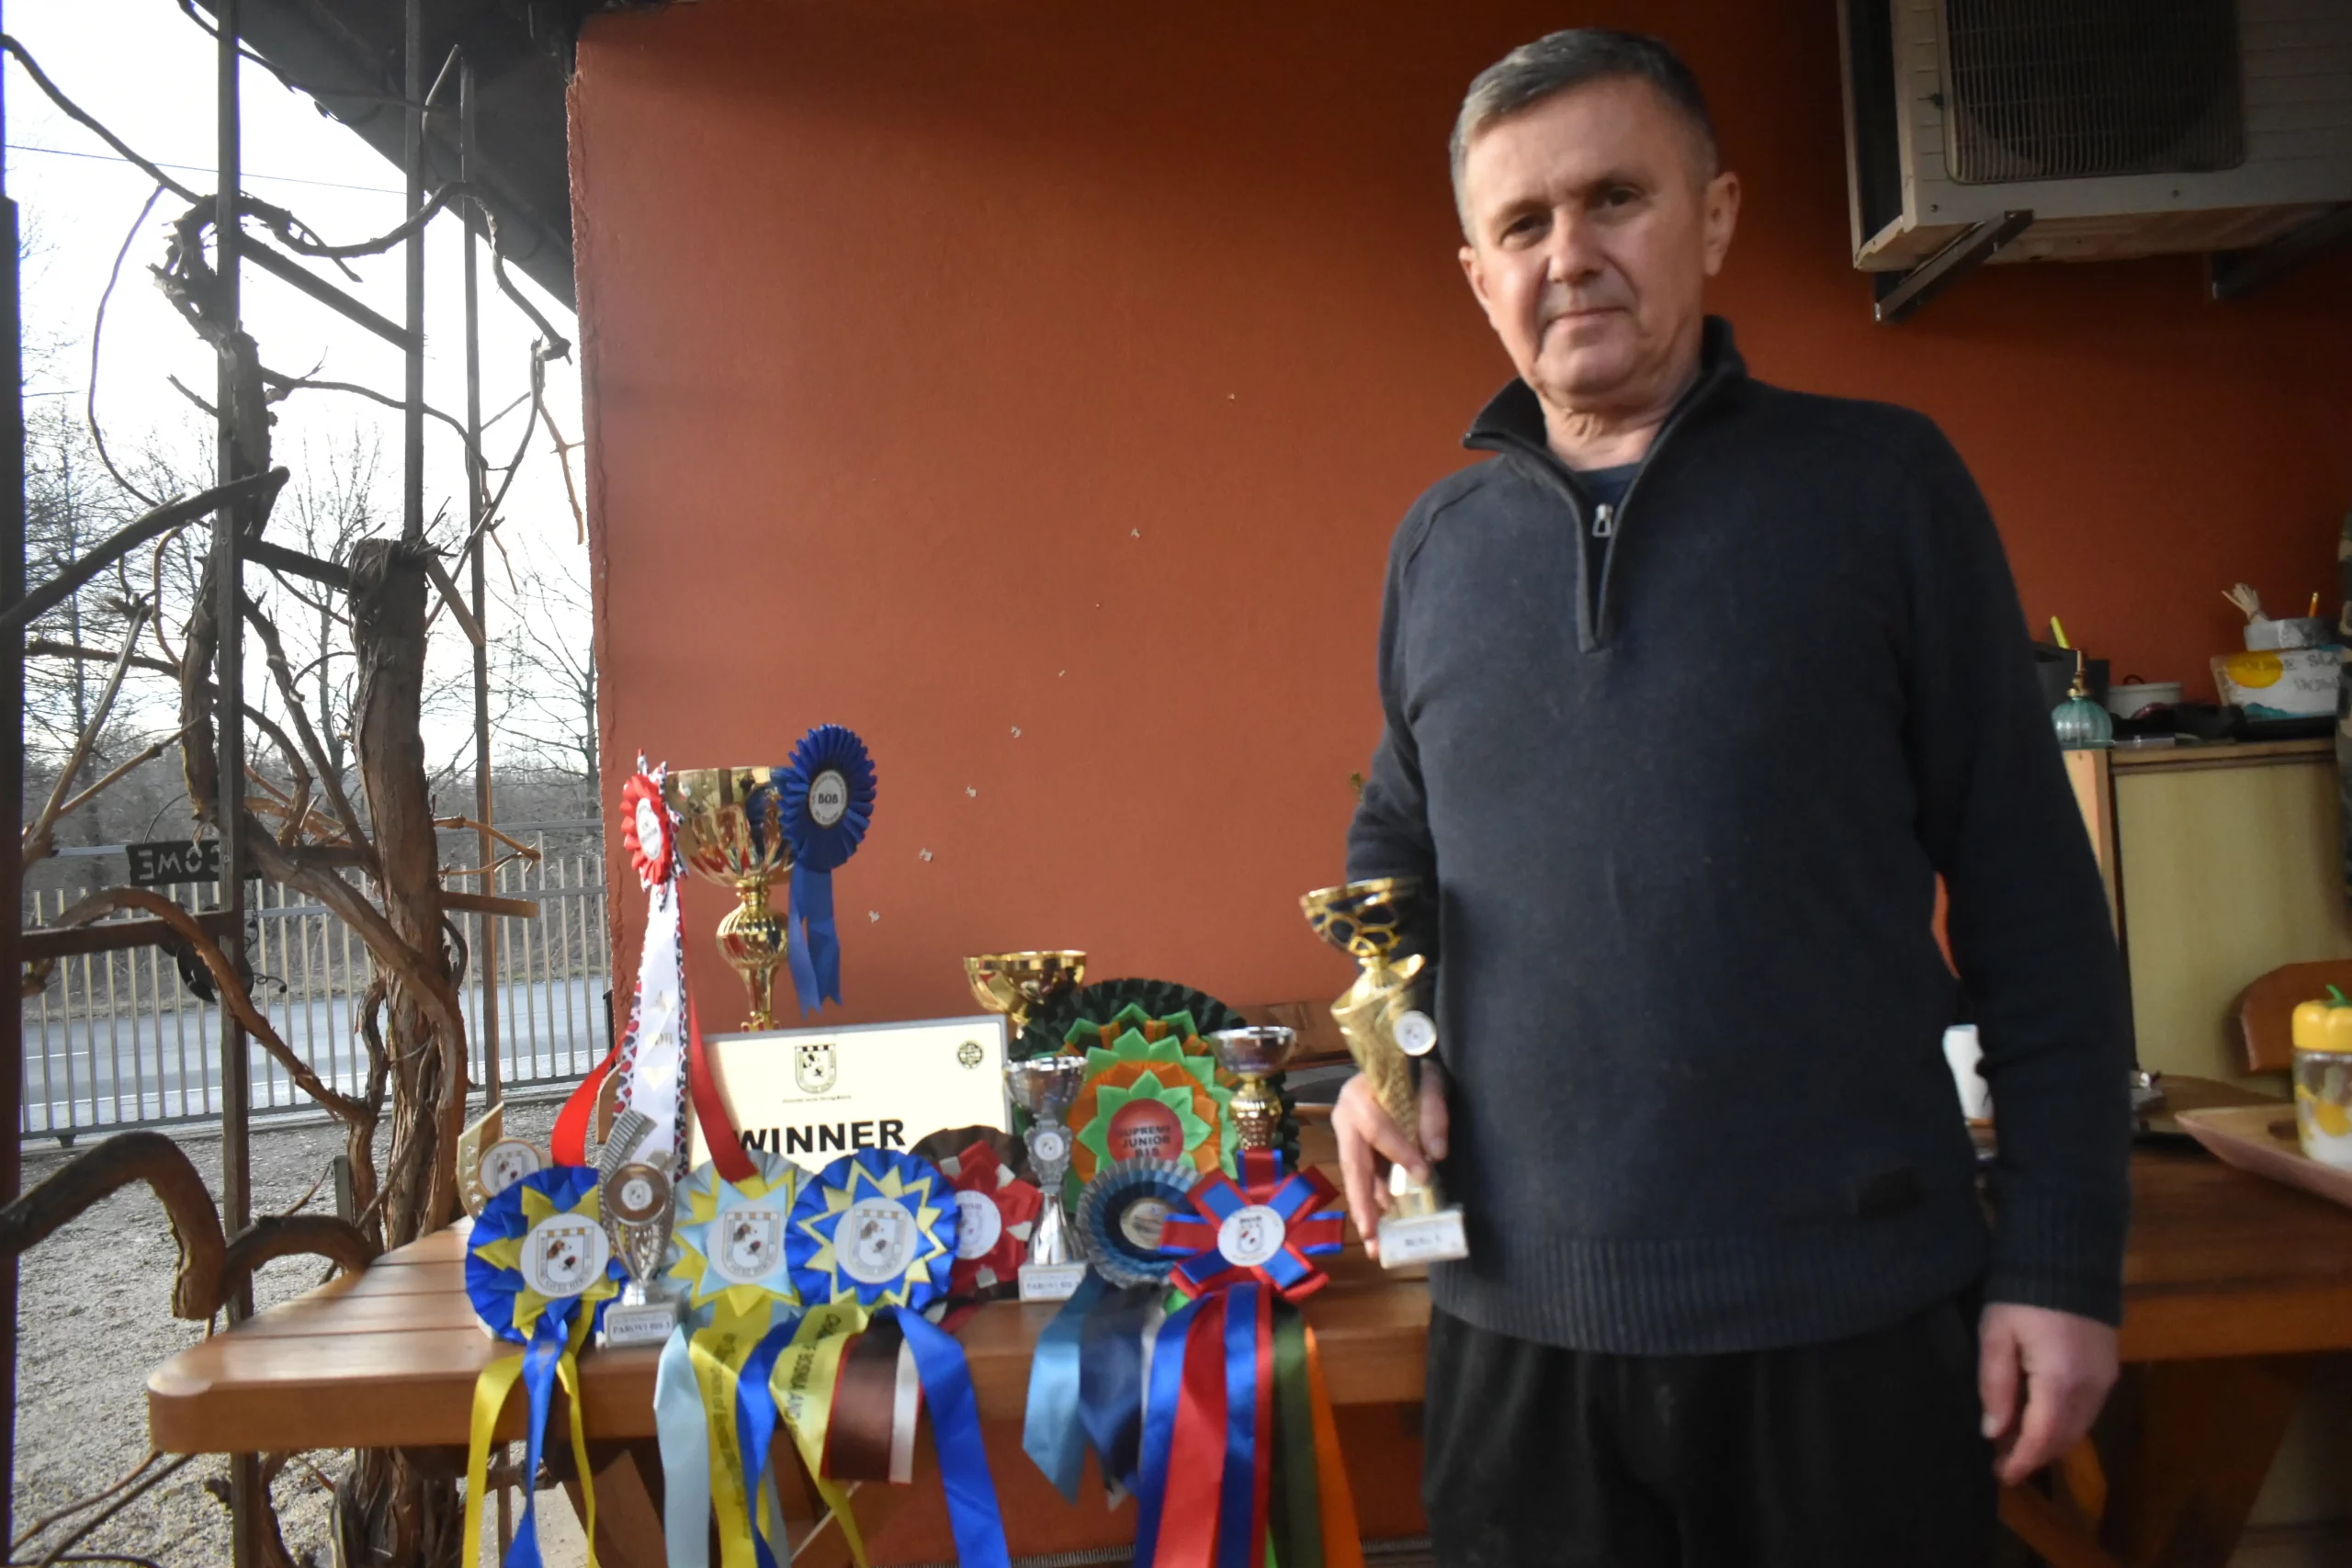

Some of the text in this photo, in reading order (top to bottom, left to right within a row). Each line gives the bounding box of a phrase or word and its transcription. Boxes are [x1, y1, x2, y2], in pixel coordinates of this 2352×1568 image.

[818, 793, 839, 804] BOB
[741, 1119, 906, 1155] WINNER
[1123, 1134, 1170, 1148] JUNIOR
